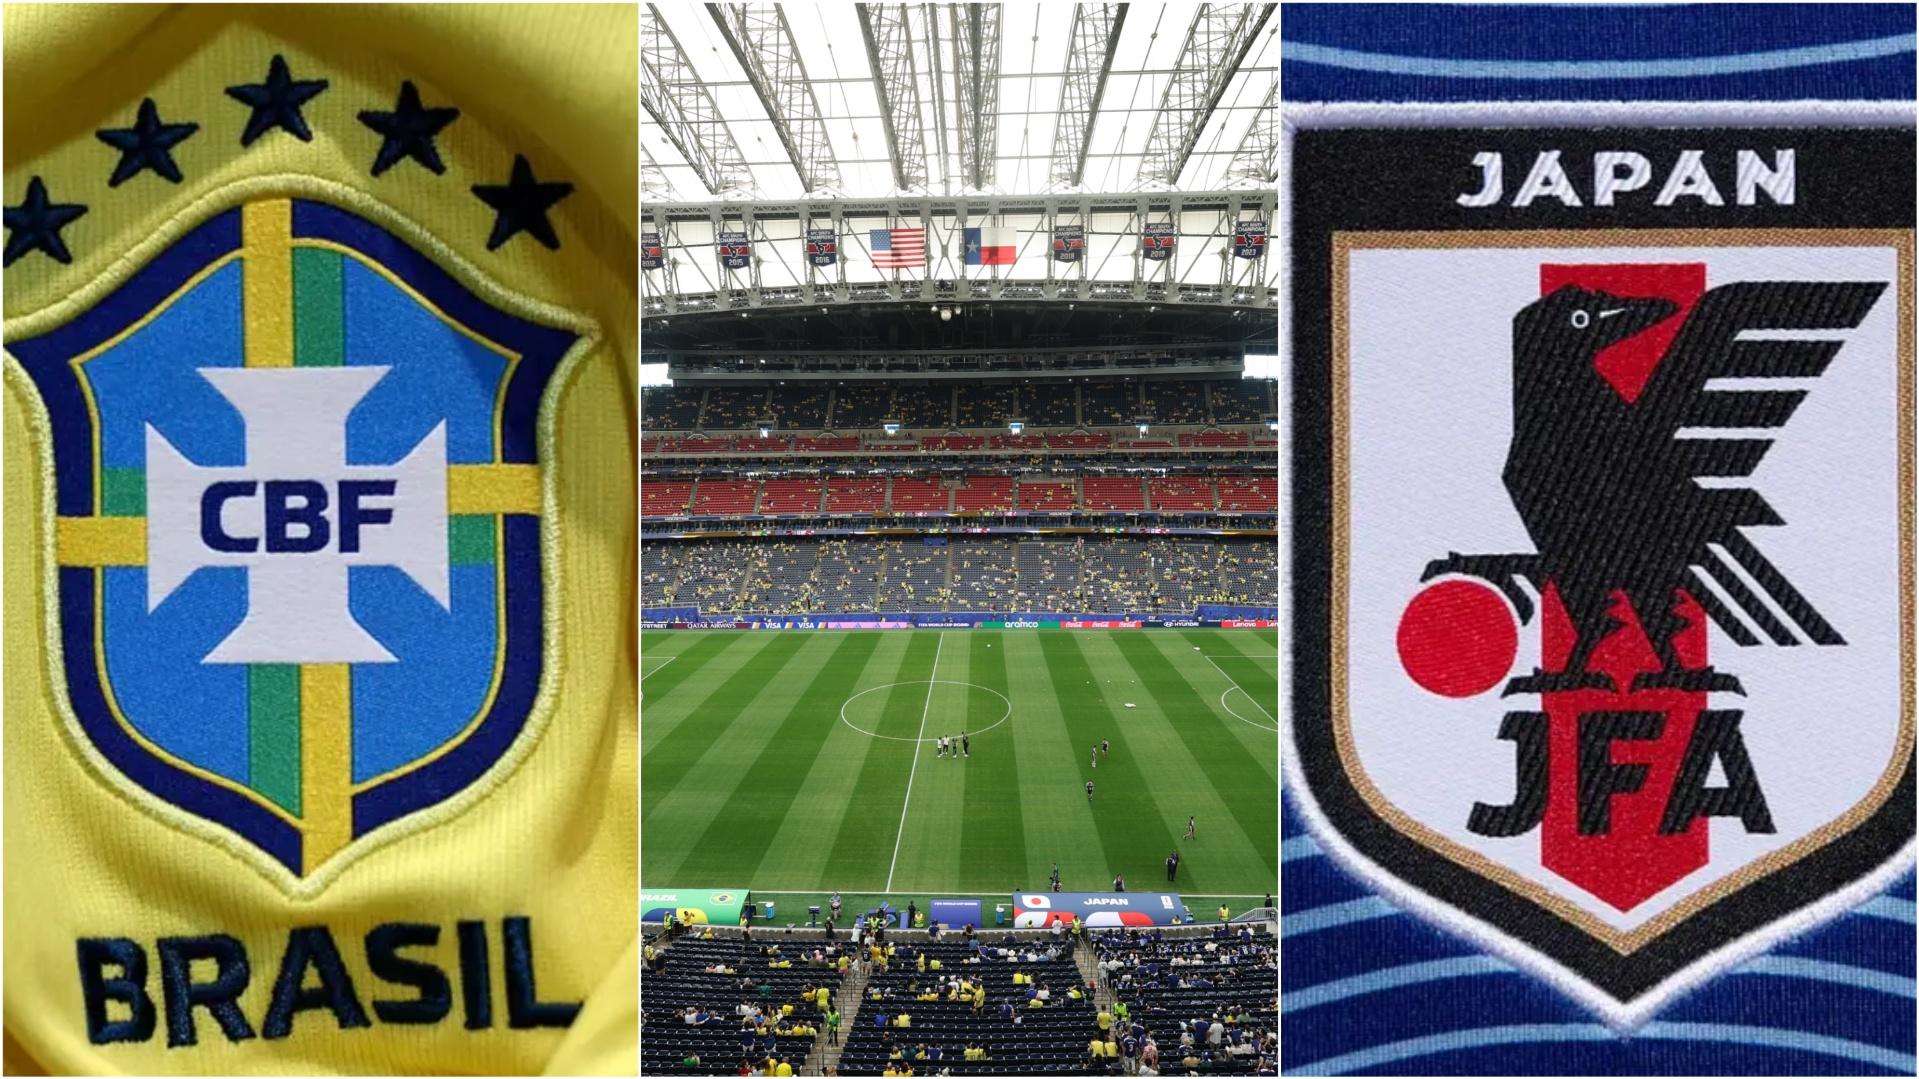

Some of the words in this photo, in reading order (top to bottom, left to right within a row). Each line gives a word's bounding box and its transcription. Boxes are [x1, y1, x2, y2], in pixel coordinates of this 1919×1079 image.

[1456, 148, 1795, 207] JAPAN
[728, 258, 743, 266] 2015
[199, 479, 398, 553] CBF
[1466, 709, 1778, 838] JFA
[76, 916, 585, 1048] BRASIL
